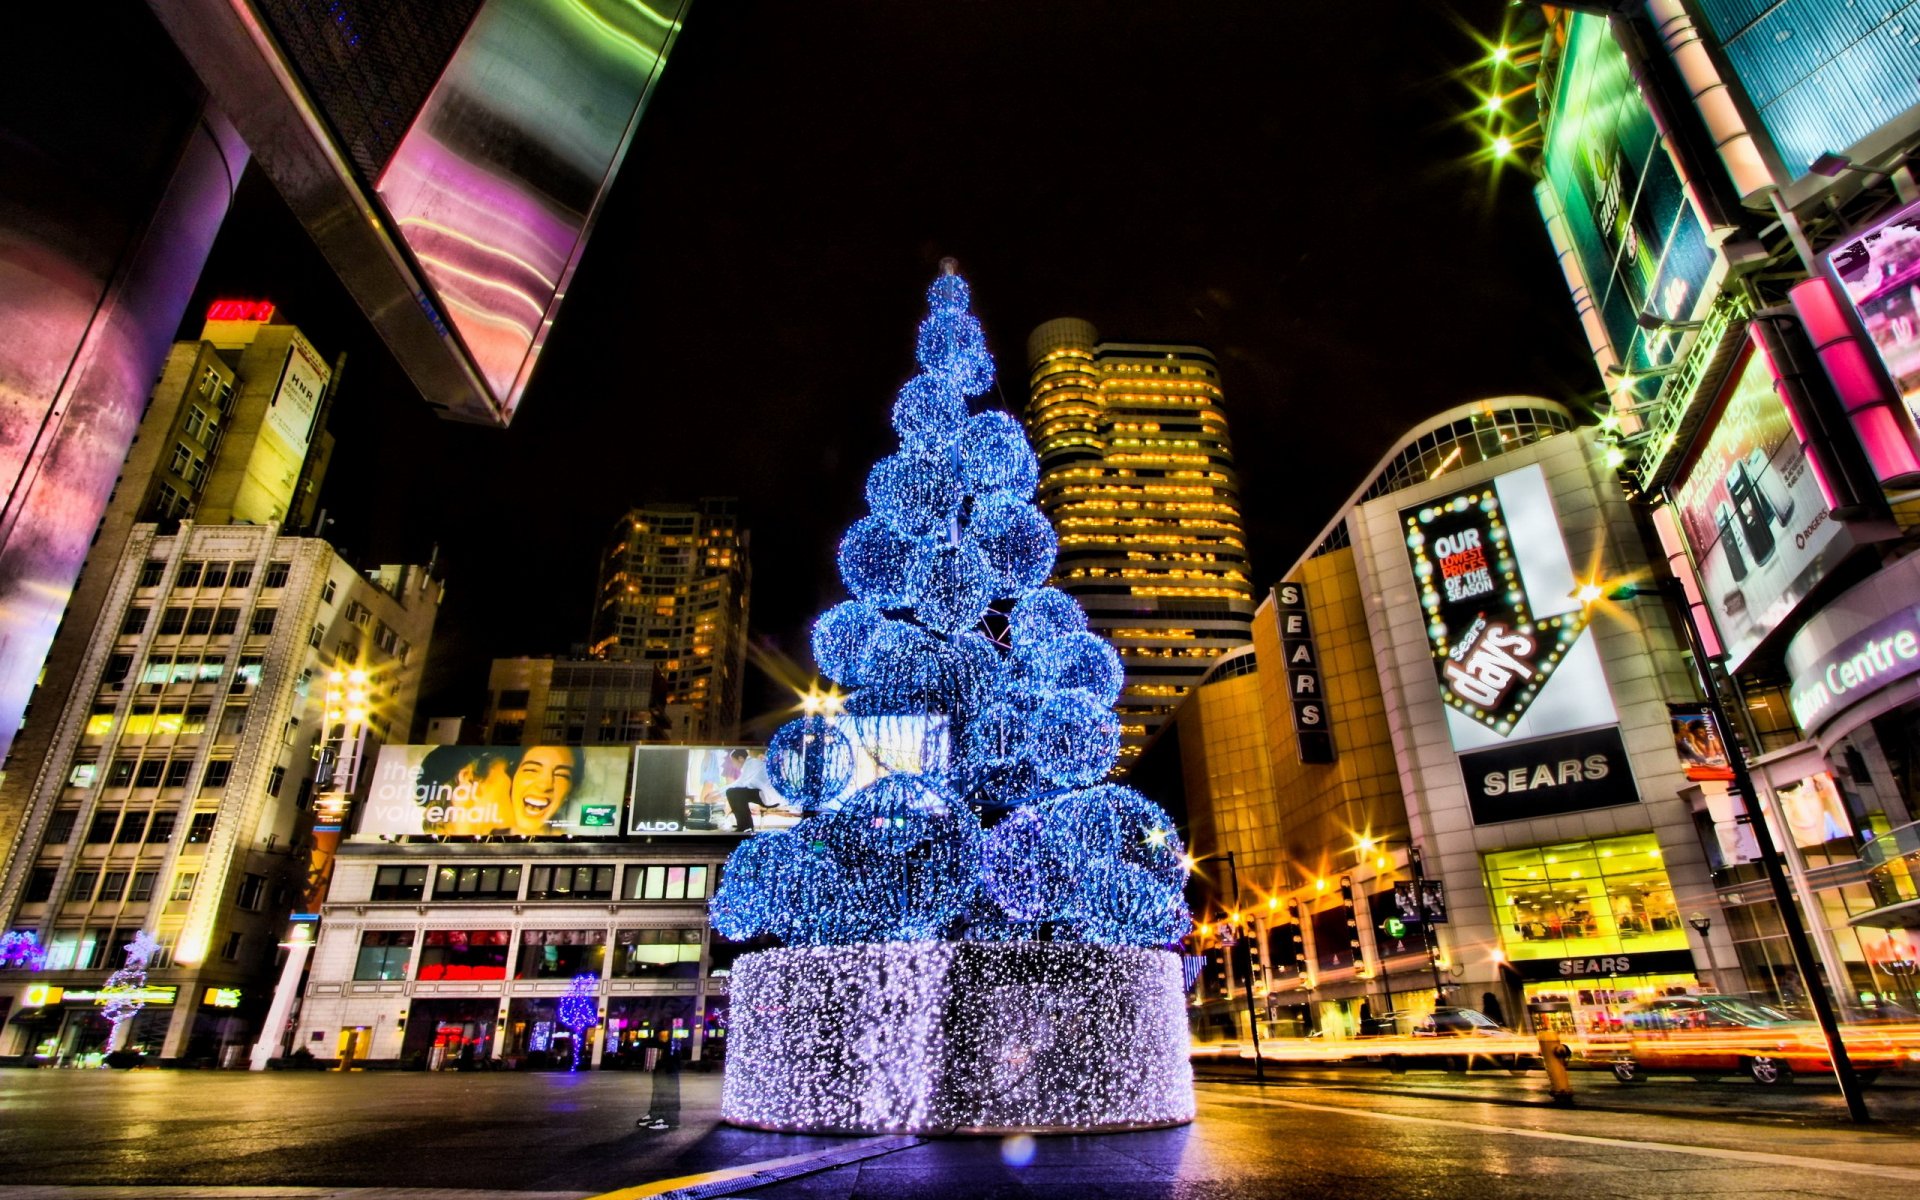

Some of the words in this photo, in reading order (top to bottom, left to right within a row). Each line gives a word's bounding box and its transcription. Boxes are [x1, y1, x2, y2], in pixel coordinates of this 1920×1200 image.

[292, 374, 313, 401] HNR
[1803, 508, 1829, 541] ROGERS
[1434, 528, 1481, 559] OUR
[1439, 547, 1483, 569] LOWEST
[1443, 557, 1487, 580] PRICES
[1445, 575, 1464, 592] OF
[1465, 567, 1490, 585] THE
[1447, 579, 1493, 601] SEASON
[1449, 618, 1487, 662] Sears
[1281, 586, 1320, 725] SEARS
[1446, 626, 1533, 707] days
[1826, 630, 1918, 695] Centre
[1700, 706, 1715, 741] DINING
[383, 761, 424, 780] the
[1483, 754, 1609, 796] SEARS
[379, 781, 479, 806] original
[375, 803, 503, 823] voicemail.
[636, 821, 679, 831] ALDO
[1559, 956, 1630, 975] SEARS
